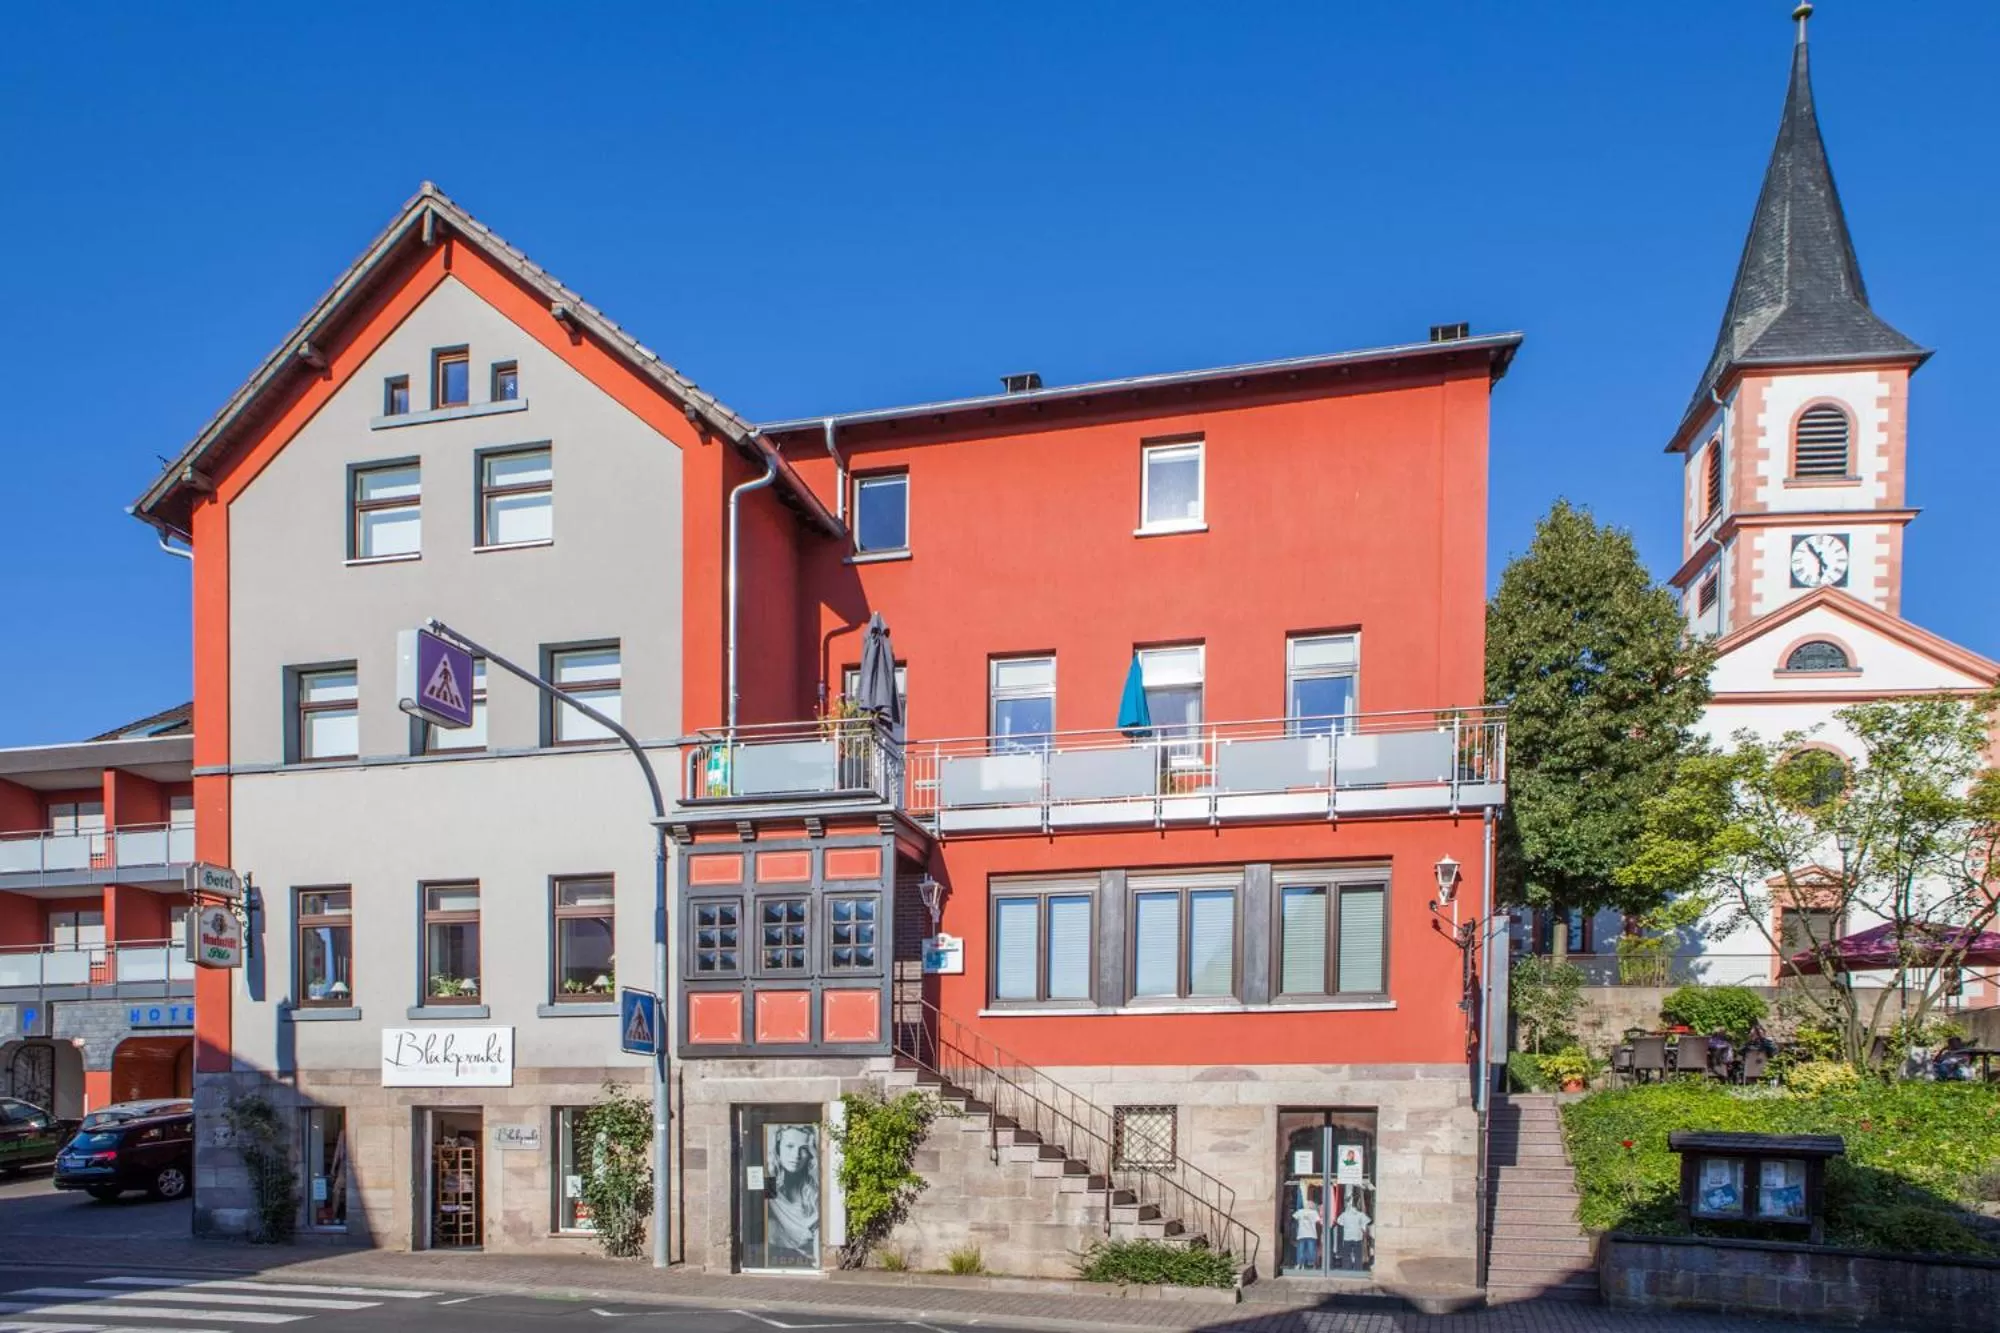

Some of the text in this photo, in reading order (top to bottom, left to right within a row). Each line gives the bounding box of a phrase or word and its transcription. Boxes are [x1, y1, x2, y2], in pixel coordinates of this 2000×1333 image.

[206, 871, 233, 889] Hotel
[22, 1008, 37, 1030] P
[384, 1031, 505, 1077] Blickpunkt
